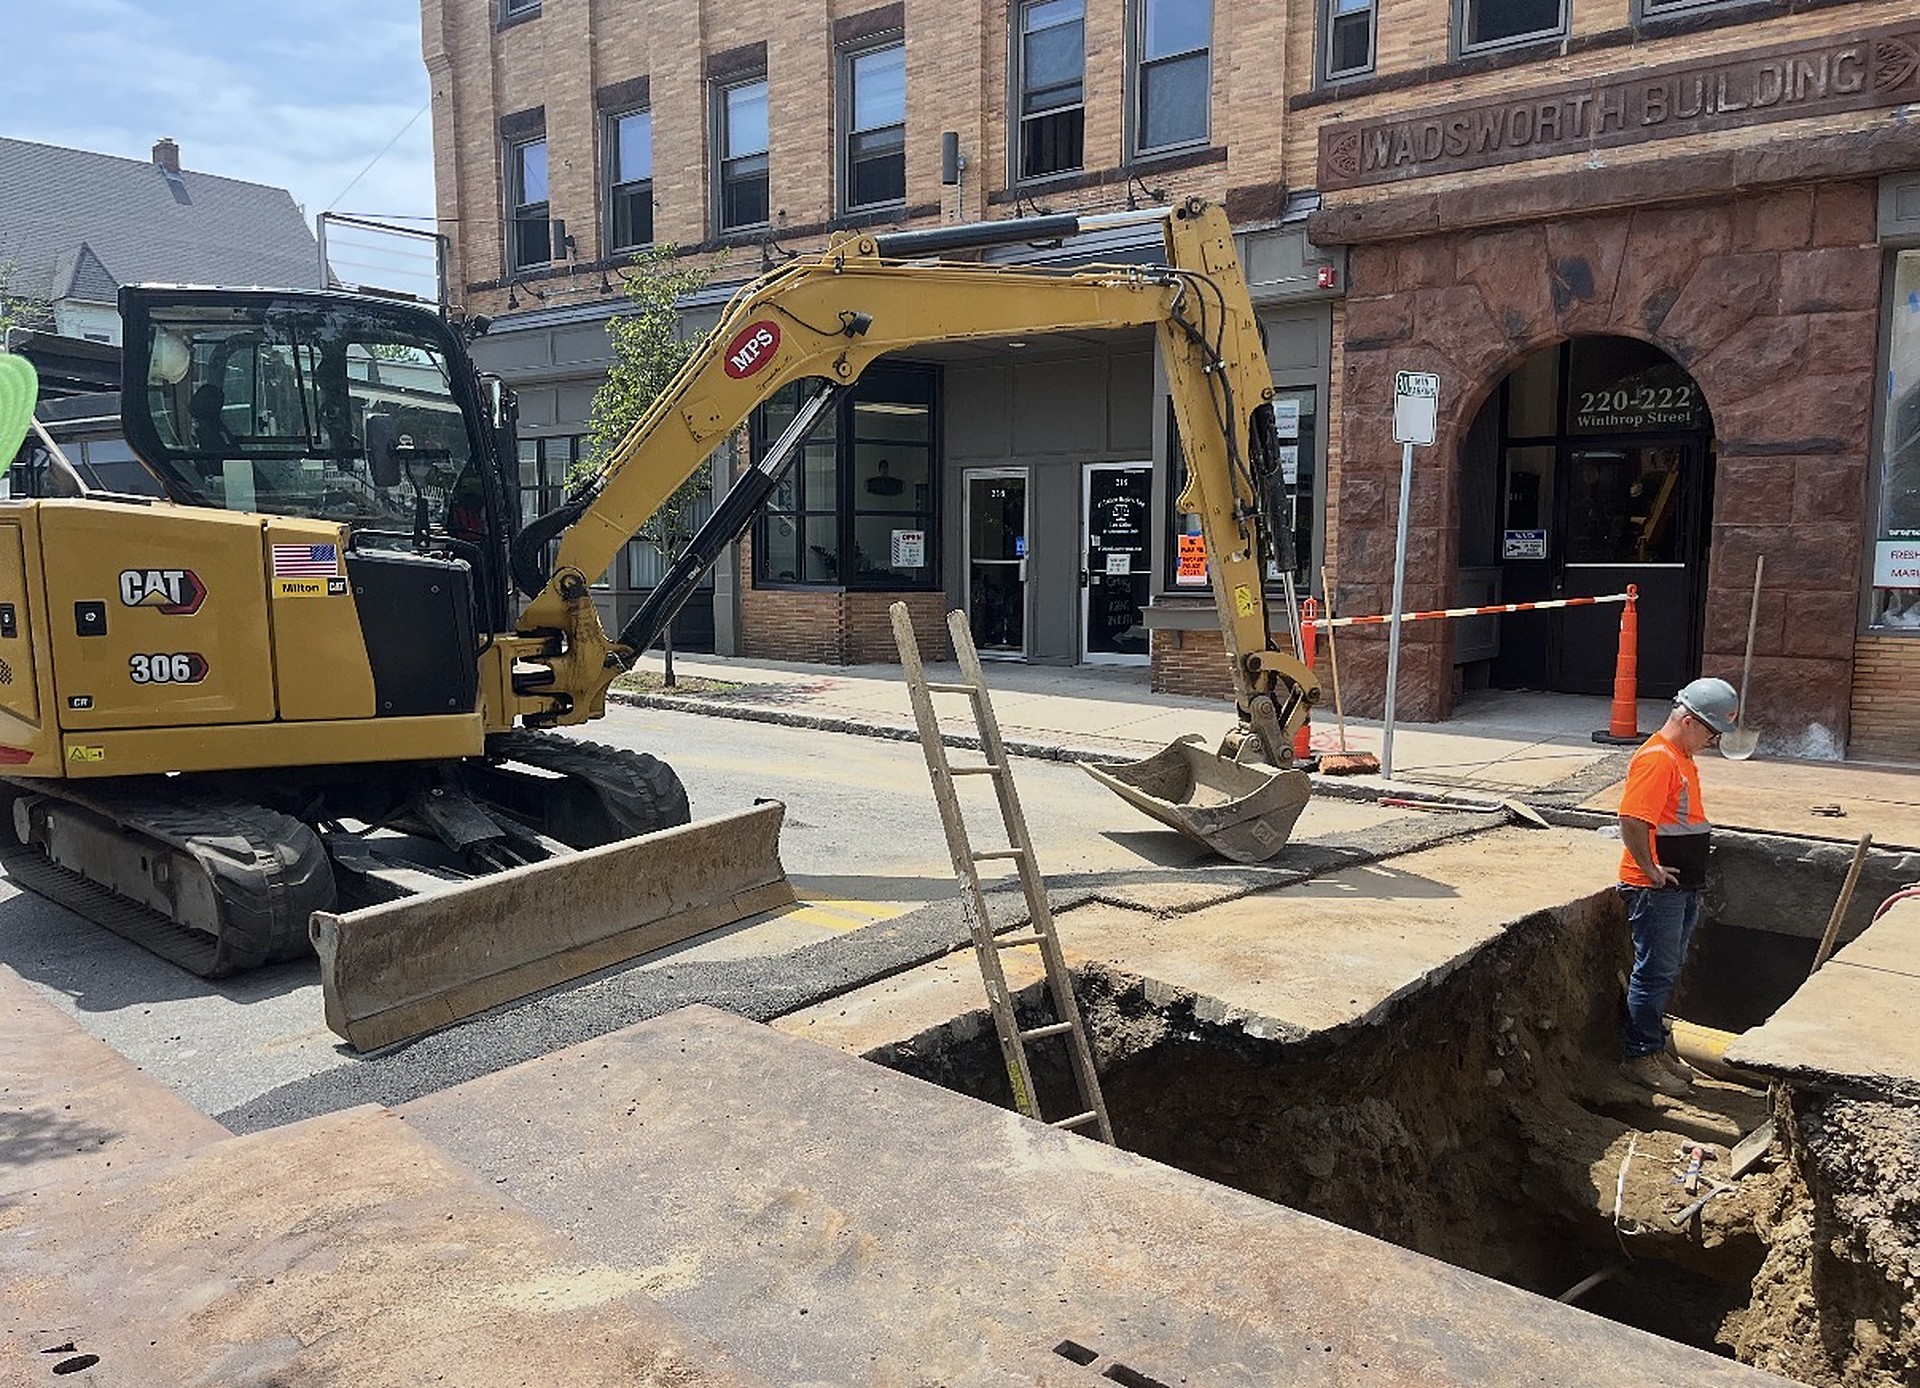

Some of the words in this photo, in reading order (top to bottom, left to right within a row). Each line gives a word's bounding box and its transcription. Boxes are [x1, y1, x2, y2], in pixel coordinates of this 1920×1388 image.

[1363, 89, 1627, 171] WADSWORTH
[1640, 49, 1866, 127] BUILDING
[731, 328, 773, 372] MPS
[1580, 386, 1690, 413] 220-222
[1577, 414, 1643, 428] Winthrop
[1647, 410, 1691, 425] Street
[120, 570, 184, 606] CAT
[281, 582, 321, 594] Milton
[328, 580, 345, 592] CAT
[130, 654, 191, 682] 306
